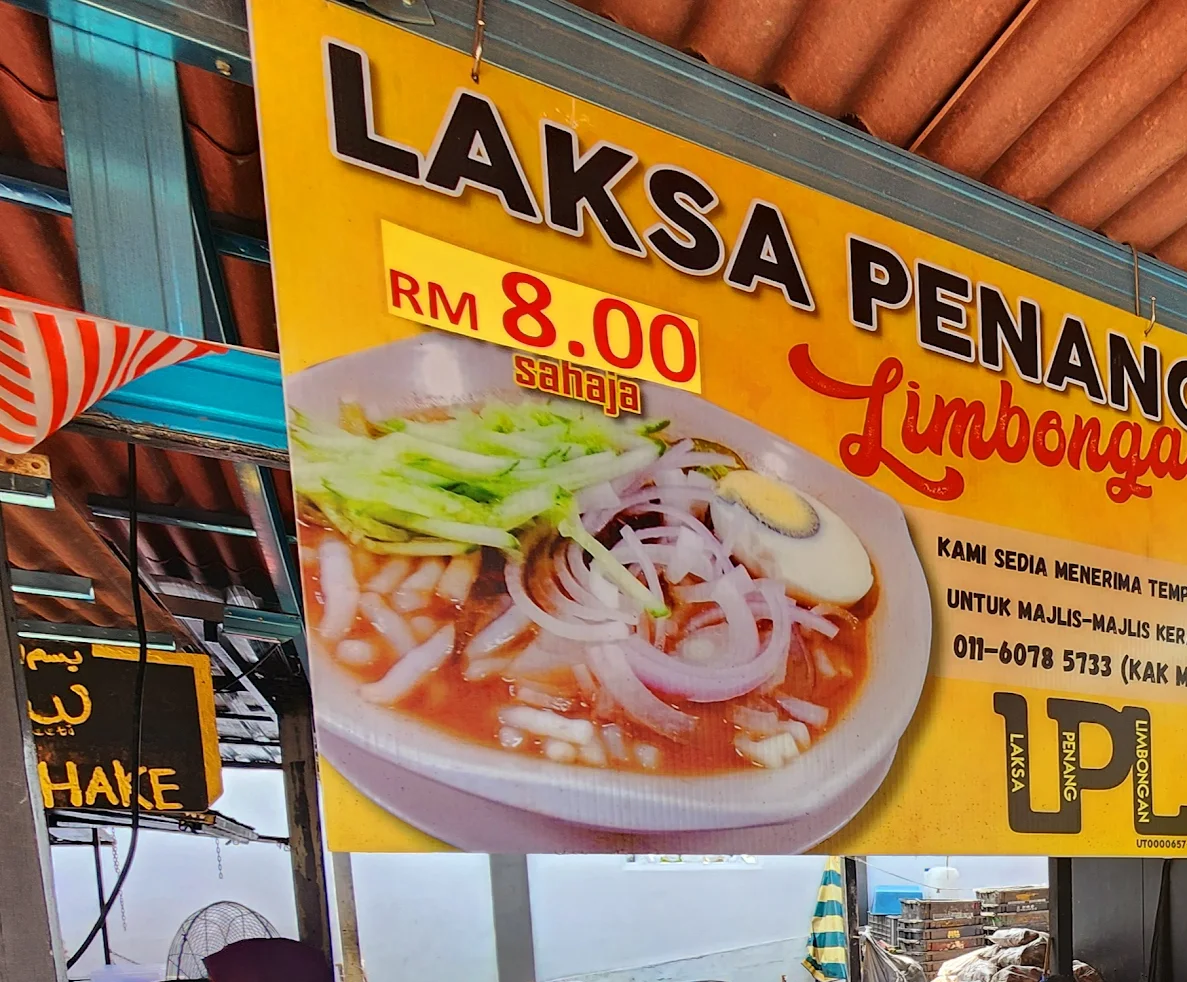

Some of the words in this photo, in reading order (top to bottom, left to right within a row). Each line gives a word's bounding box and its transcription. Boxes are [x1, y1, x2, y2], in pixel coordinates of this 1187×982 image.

[323, 37, 814, 311] LAKSA
[389, 268, 479, 331] RM
[501, 271, 698, 383] 8.00
[512, 353, 642, 418] sahaja
[937, 536, 987, 566] KAMI
[994, 548, 1048, 577] SEDIA
[1054, 559, 1142, 595] MENERIMA
[947, 588, 1011, 617] UNTUK
[1017, 602, 1150, 639] MAJLIS-MAJLIS
[953, 634, 1054, 669] 011-6078
[1063, 649, 1112, 677] 5733
[1121, 654, 1168, 685] (KAK
[1009, 732, 1026, 793] LAKSA
[1062, 731, 1078, 802] PENANG
[1135, 719, 1150, 824] LIMBONGAN
